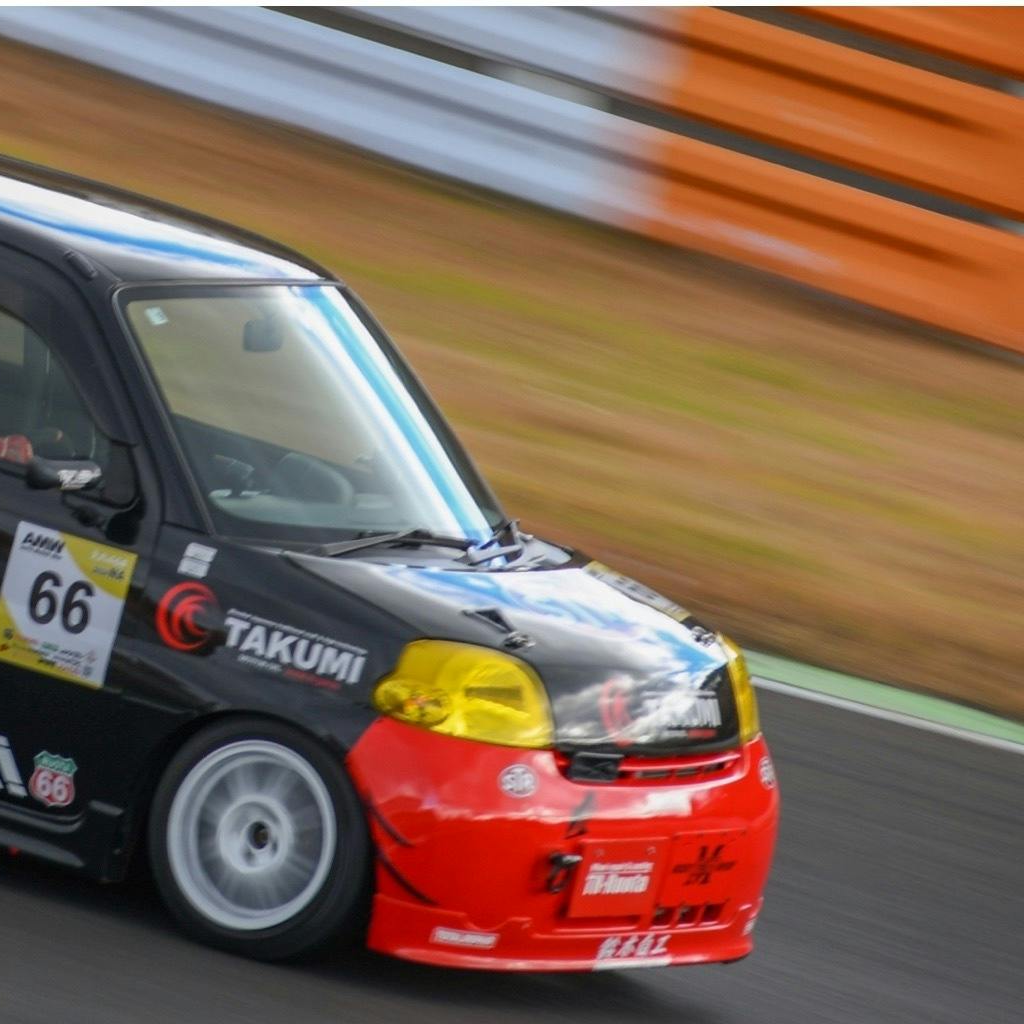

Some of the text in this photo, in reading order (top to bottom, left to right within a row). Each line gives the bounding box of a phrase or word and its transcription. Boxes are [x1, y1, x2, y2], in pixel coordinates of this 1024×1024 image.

[29, 569, 95, 635] 66
[224, 616, 368, 685] TAKUMI
[35, 769, 67, 802] 66
